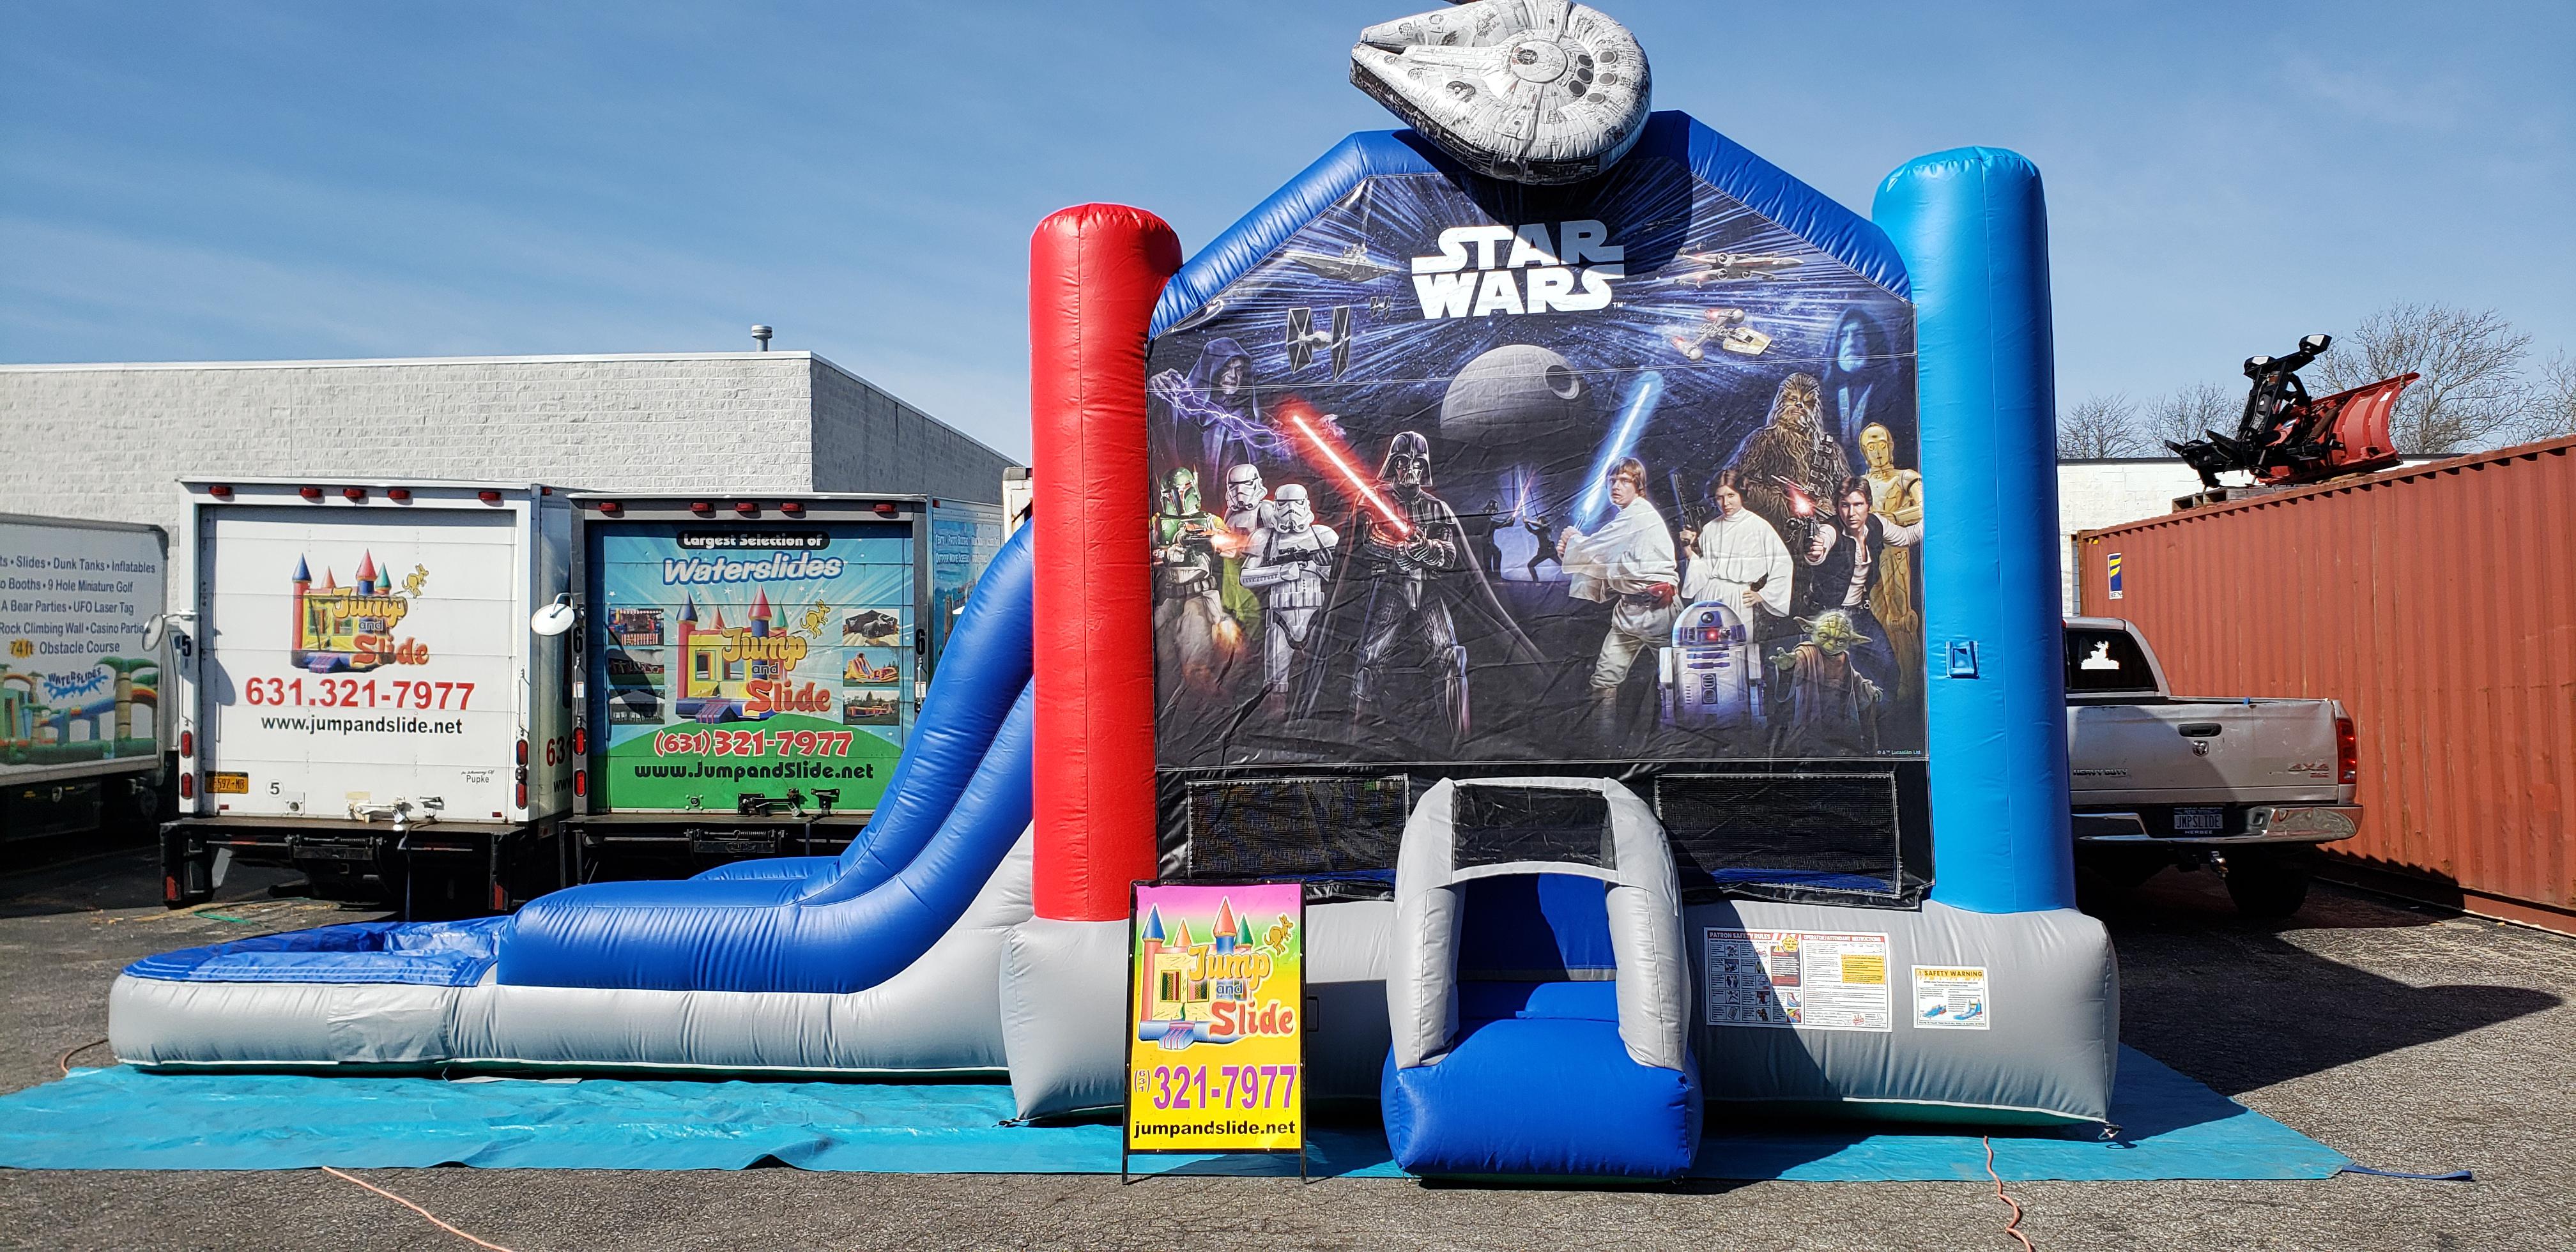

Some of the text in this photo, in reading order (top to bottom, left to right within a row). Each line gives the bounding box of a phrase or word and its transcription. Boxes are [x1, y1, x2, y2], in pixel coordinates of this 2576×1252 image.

[1411, 219, 1624, 274] STAR
[1411, 263, 1625, 320] WARS
[684, 533, 823, 549] Largest Selection of
[17, 556, 45, 569] Slides
[54, 558, 77, 570] Dunk
[80, 559, 105, 571] Tanks
[112, 561, 155, 574] Inflatables
[663, 551, 844, 584] Waterslides
[8, 577, 41, 590] Booths
[48, 579, 54, 590] 9
[56, 579, 76, 592] Hole
[78, 580, 114, 592] Miniature
[116, 581, 134, 593] Golf
[2, 600, 134, 616] A Bear Parties UFO Laser Tag
[332, 586, 408, 628] Jump
[0, 622, 147, 637] Rock Climbing Wall Casino Partie
[358, 619, 383, 631] and
[40, 641, 84, 654] Obstacle
[86, 640, 120, 653] Course
[182, 635, 191, 656] 5
[351, 634, 430, 666] Slide
[573, 627, 583, 653] 6
[721, 627, 807, 671] Jump
[916, 629, 925, 655] 6
[752, 662, 779, 675] and
[245, 676, 475, 711] 631.321-7977
[744, 679, 831, 713] Slide
[261, 715, 463, 735] www.jumpandslide.net
[466, 775, 489, 784] Pupke
[634, 760, 874, 782] www.JumpandSlide.net
[270, 782, 280, 795] 5
[2177, 815, 2220, 828] JMPSLIDE
[1186, 943, 1272, 990] Jump
[1216, 982, 1243, 996] and
[1209, 1001, 1294, 1035] Slide
[1153, 1065, 1297, 1109] 321-7977
[1133, 1120, 1296, 1138] jumpandslide.net
